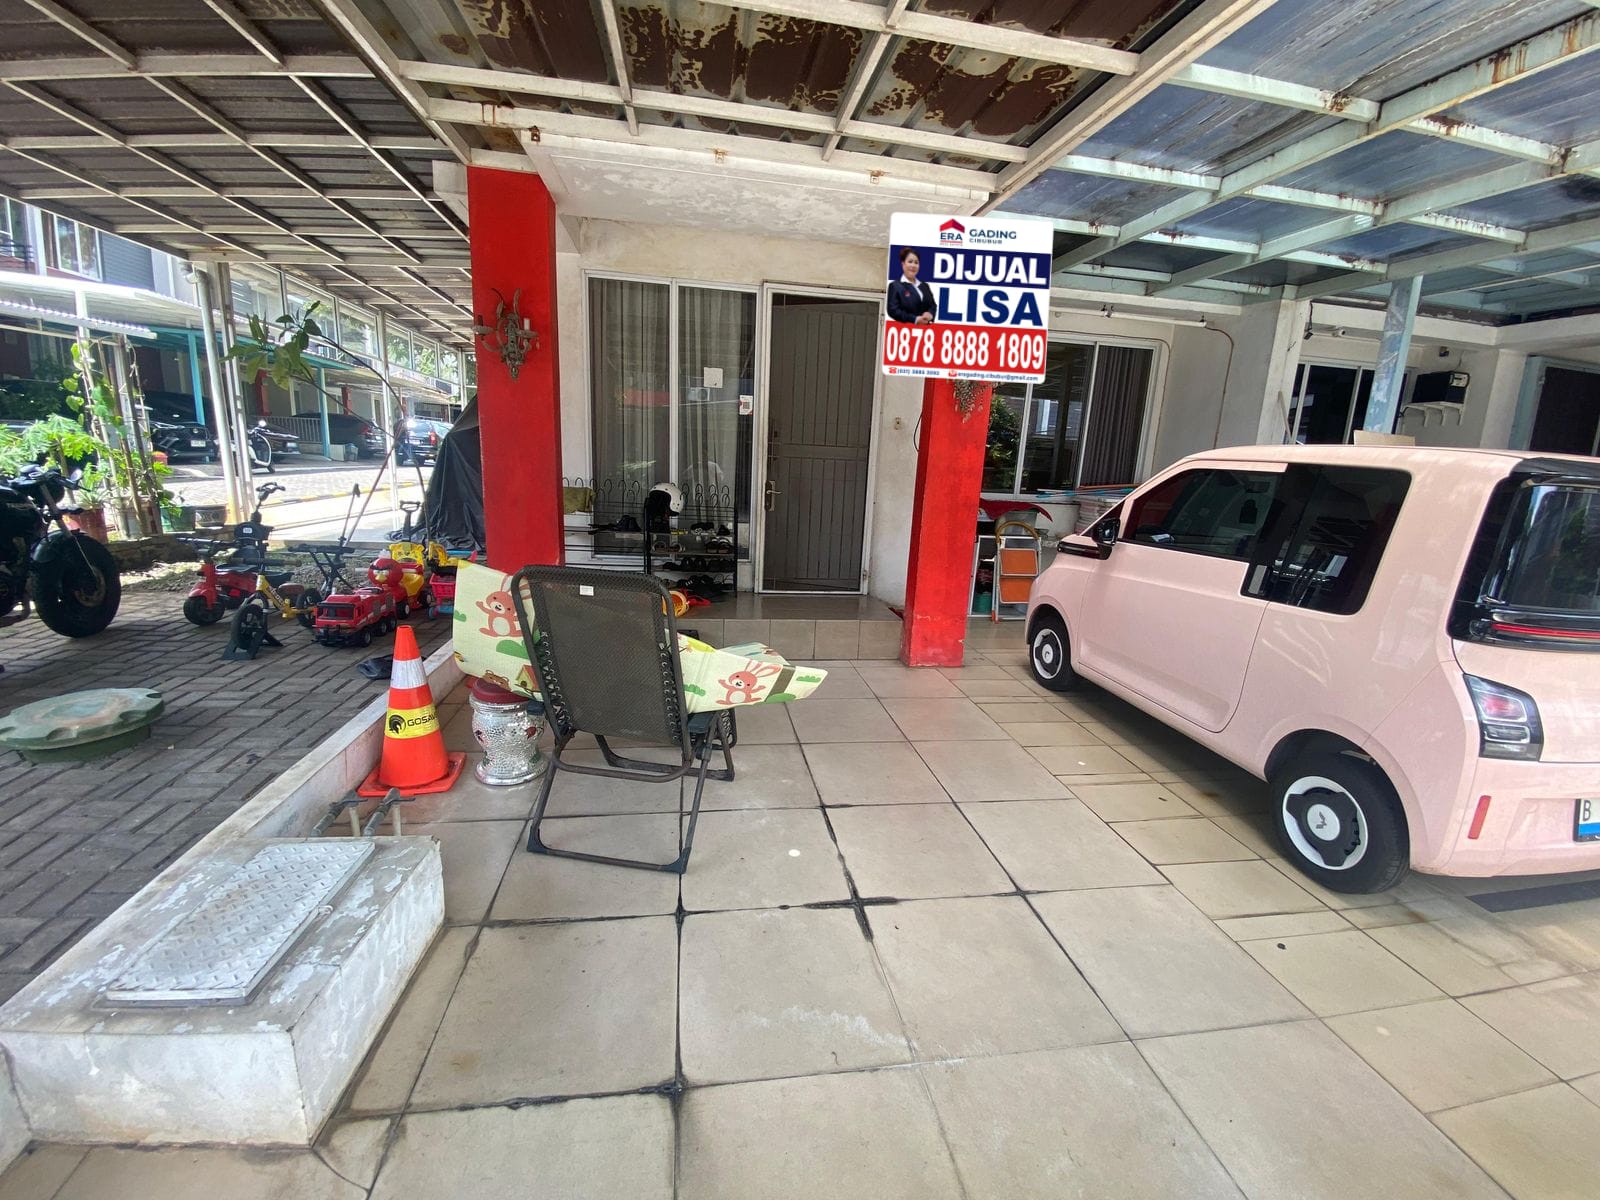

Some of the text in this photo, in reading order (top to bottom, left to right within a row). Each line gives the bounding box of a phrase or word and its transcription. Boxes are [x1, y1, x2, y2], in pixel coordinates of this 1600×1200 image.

[940, 232, 963, 241] ERA
[969, 228, 1017, 240] GADING
[933, 252, 1047, 285] DIJUAL
[938, 287, 1043, 327] LISA
[886, 327, 1044, 370] 0878 8888 1809
[1582, 799, 1592, 822] B
